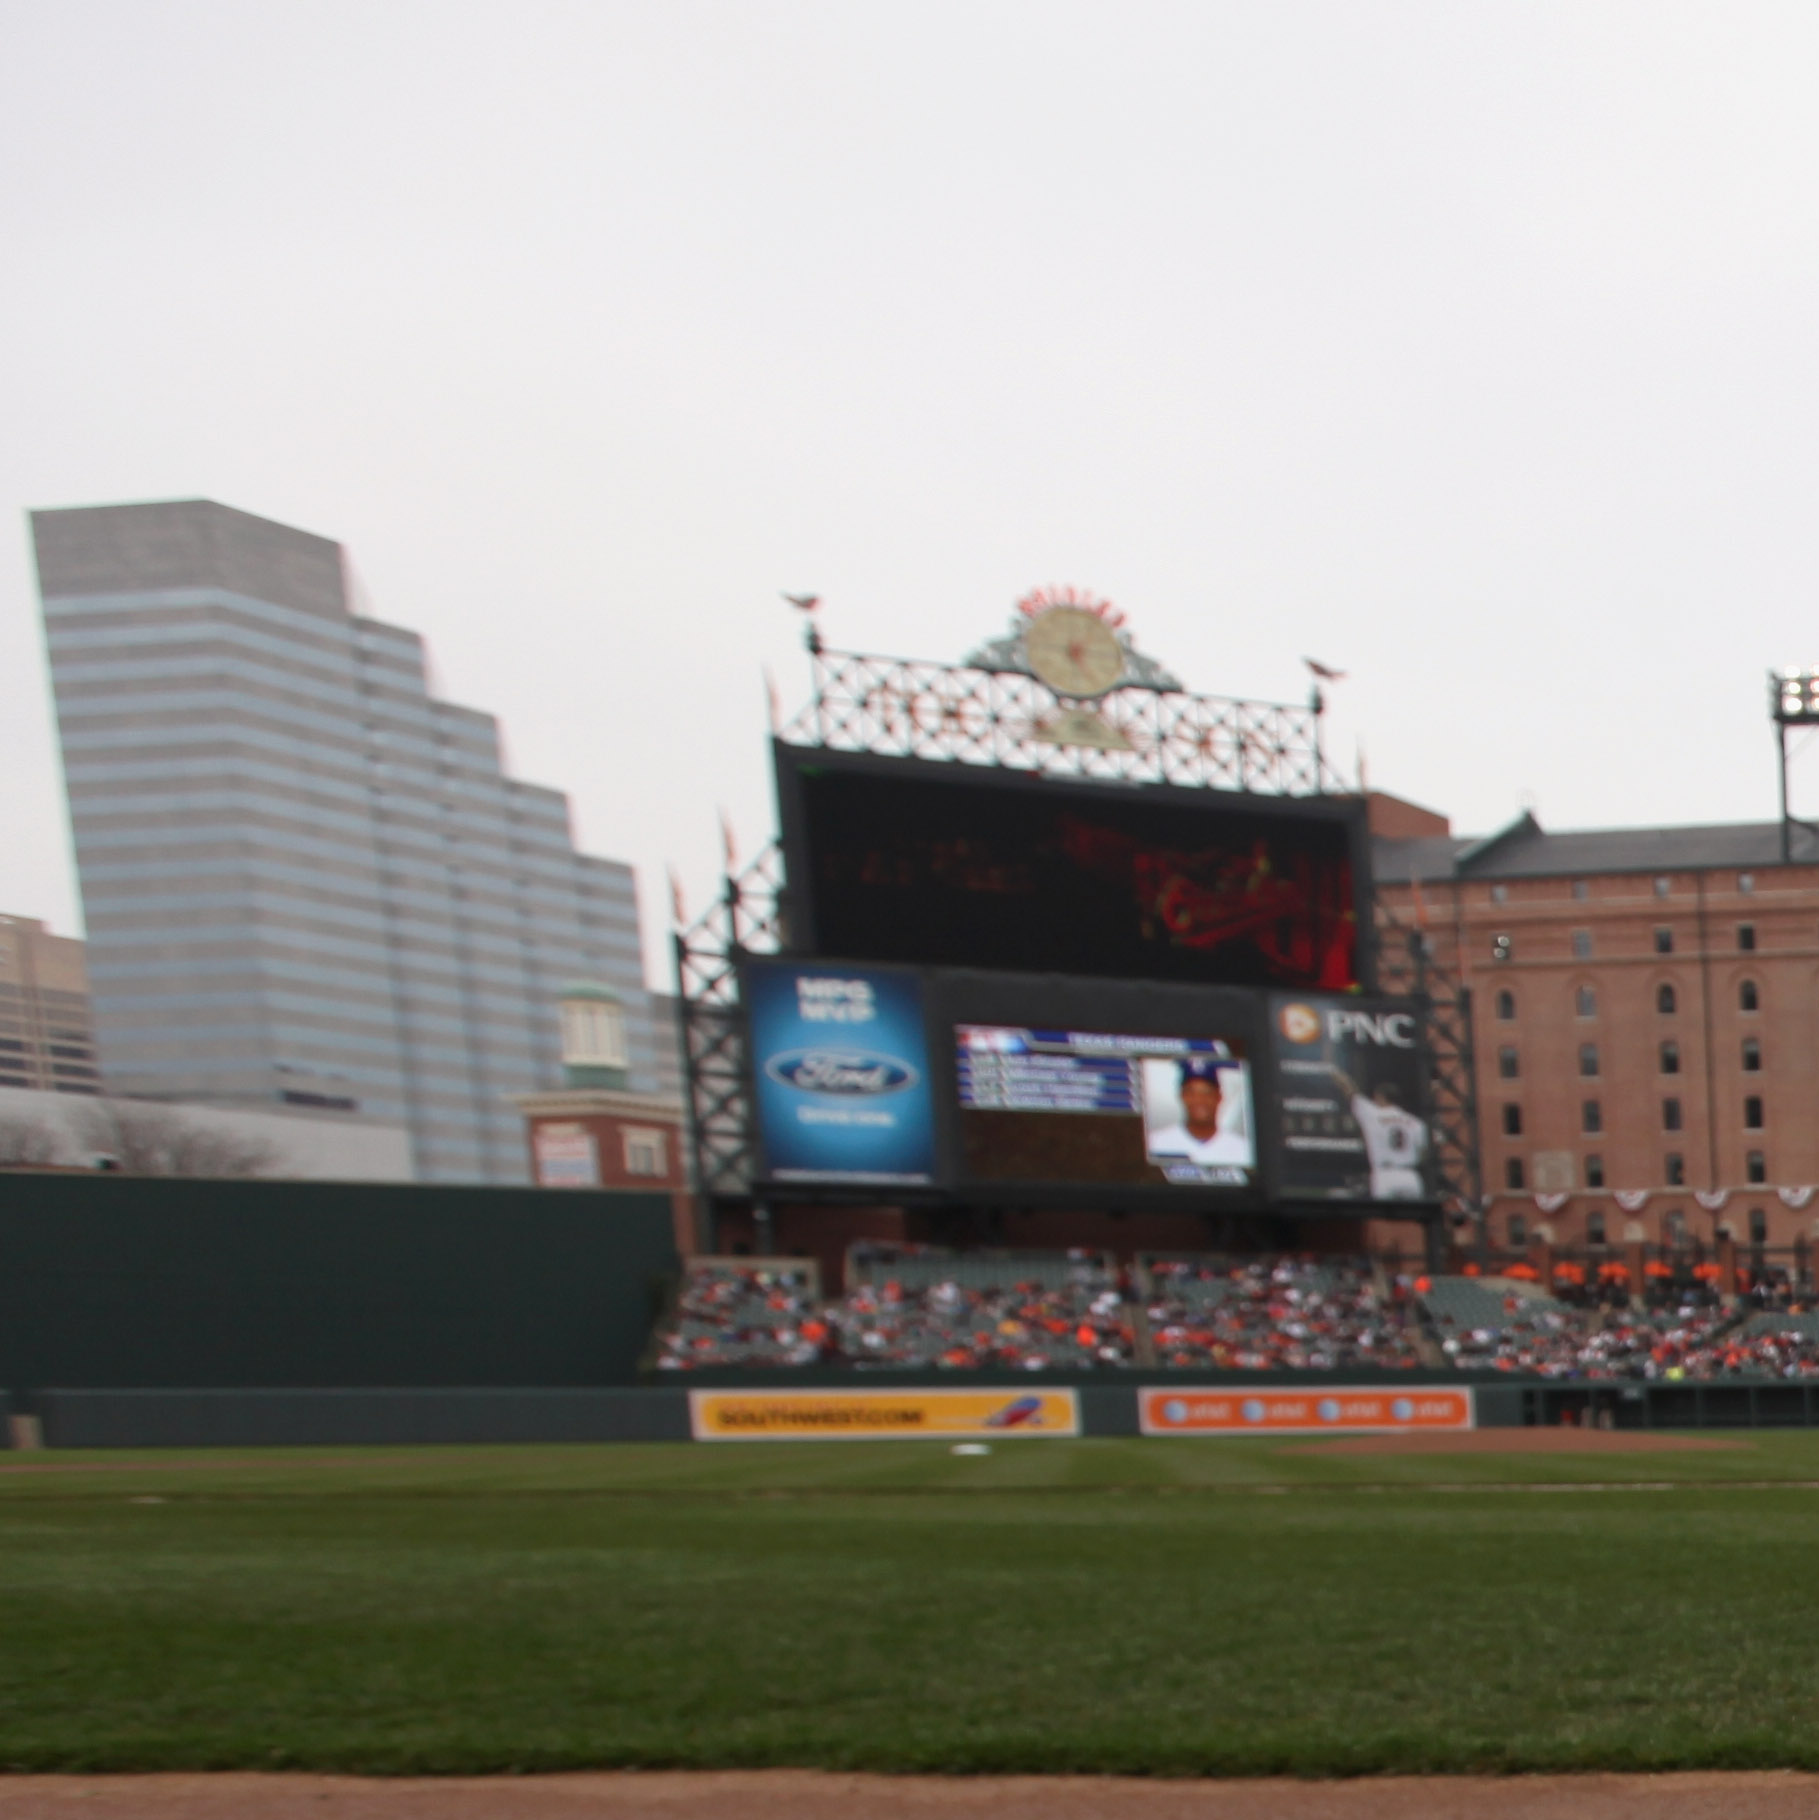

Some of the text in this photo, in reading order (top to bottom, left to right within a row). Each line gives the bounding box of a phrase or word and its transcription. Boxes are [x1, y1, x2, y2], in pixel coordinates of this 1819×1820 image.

[1326, 1009, 1416, 1048] PNC
[794, 1052, 890, 1090] Ford
[718, 1409, 925, 1426] SOUTHWEST.COM
